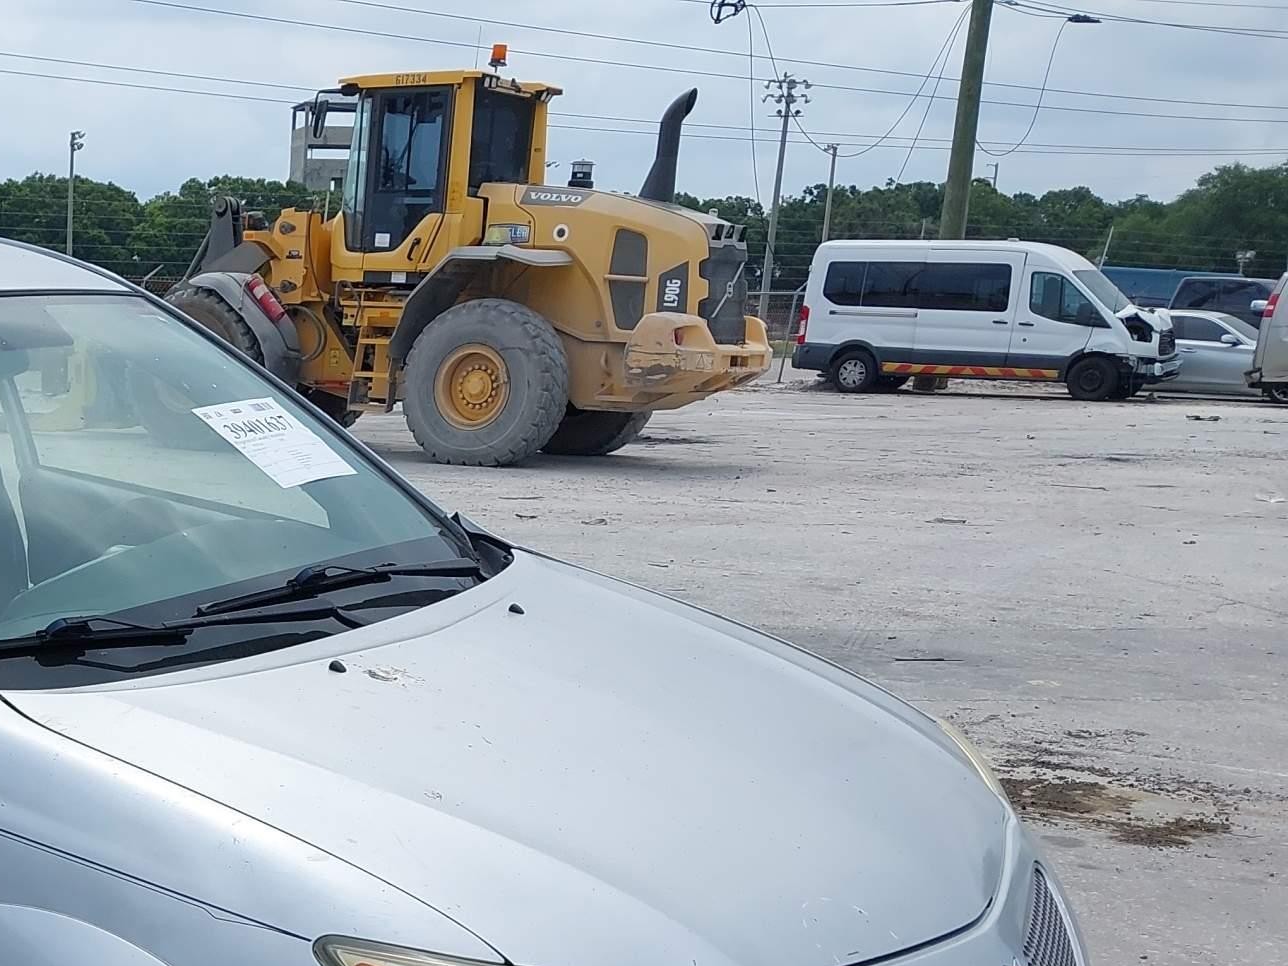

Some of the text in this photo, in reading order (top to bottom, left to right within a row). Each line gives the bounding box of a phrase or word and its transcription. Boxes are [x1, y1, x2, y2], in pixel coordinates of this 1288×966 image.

[530, 191, 582, 203] VOLVO
[663, 279, 681, 307] L90G
[223, 415, 294, 439] 39401637
